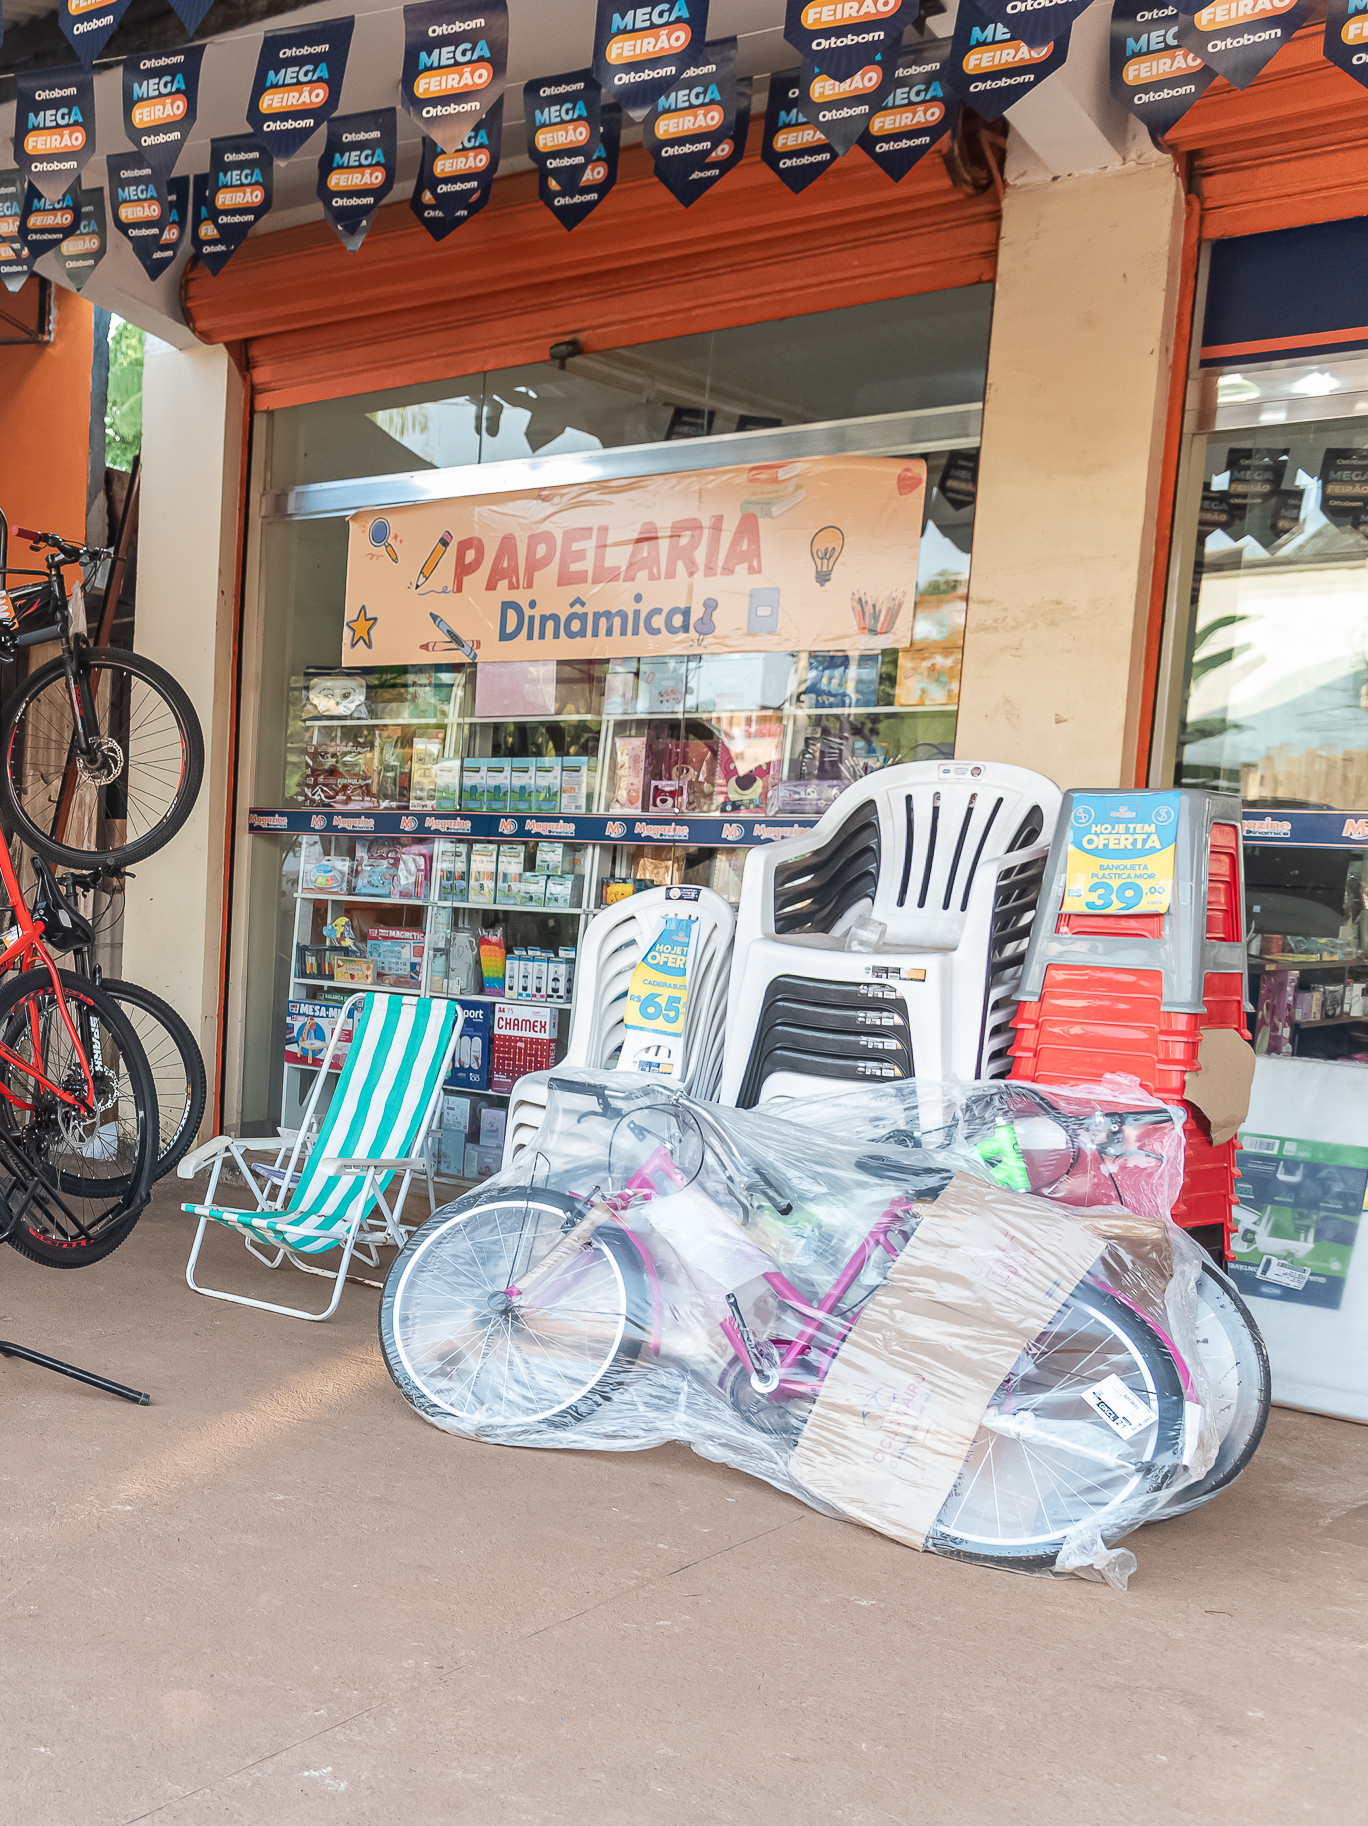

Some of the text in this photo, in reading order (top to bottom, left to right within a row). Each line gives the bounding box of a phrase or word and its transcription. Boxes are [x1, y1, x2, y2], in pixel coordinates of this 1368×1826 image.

[611, 0, 690, 33] MEGA
[1136, 6, 1178, 22] Ortob
[73, 14, 114, 35] Ortobom
[428, 17, 485, 37] Ortobom
[609, 24, 687, 61] FEIRÃO
[811, 31, 885, 51] Ortobom
[1207, 28, 1282, 53] Ortobom
[279, 43, 329, 58] Ortobom
[418, 40, 491, 70] MEGA
[139, 55, 185, 70] Ortobom
[894, 62, 941, 78] rtobom
[265, 62, 329, 87] MEGA
[418, 62, 489, 94] FEIRÃO
[613, 65, 676, 86] Ortobom
[969, 74, 1035, 93] Ortobom
[35, 87, 77, 101] Ortobom
[133, 73, 186, 101] MEGA
[540, 82, 584, 97] Ortobom
[1133, 84, 1196, 105] Ortobom
[262, 85, 325, 111] FEIRÃO
[657, 83, 721, 112] MEGA
[28, 106, 83, 129] MEGA
[134, 97, 185, 124] FEIRÃO
[422, 101, 480, 119] Ortobom
[534, 100, 588, 127] MEGA
[818, 105, 869, 122] Ortobom
[872, 105, 940, 132] FEIRÃO
[262, 118, 314, 132] Ortobom
[658, 108, 720, 137] FEIRÃO
[27, 127, 83, 150] FEIRÃO
[140, 130, 182, 147] Ortobom
[342, 129, 381, 143] Ortobom
[537, 122, 587, 150] FEIRÃO
[875, 136, 930, 153] Ortobom
[224, 151, 260, 162] Ortobom
[332, 148, 385, 169] MEGA
[661, 141, 711, 158] Ortobom
[30, 159, 77, 173] Ortobom
[436, 150, 487, 174] FEIRÃO
[546, 155, 585, 169] Ortobom
[779, 153, 830, 169] Ortobom
[120, 168, 152, 179] Ortobom
[218, 168, 263, 187] MEGA
[330, 167, 383, 189] FEIRÃO
[117, 184, 157, 201] MEGA
[437, 180, 478, 194] Ortobom
[218, 187, 263, 206] FEIRÃO
[332, 195, 374, 207] Ortobom
[29, 212, 72, 227] FEIRÃO
[120, 203, 160, 220] FEIRÃO
[218, 214, 254, 224] Ortobom
[28, 233, 63, 241] Ortobom
[128, 227, 160, 237] Ortobom
[63, 234, 99, 252] FEIRÃO
[65, 258, 95, 269] Ortobom
[452, 512, 764, 594] PAPELARIA
[499, 592, 692, 643] Dinâmica
[332, 815, 375, 830] Magazine
[425, 816, 472, 831] Magazine
[524, 819, 576, 835] Magazine
[634, 821, 690, 839] Magazine
[1091, 823, 1156, 834] HOJE TEM
[1081, 833, 1162, 850] OFERTA
[1099, 863, 1149, 871] BANQUETA
[1085, 881, 1144, 911] 39
[655, 943, 682, 955] HOJE
[647, 951, 686, 969] OFER
[639, 992, 682, 1024] 65
[497, 1016, 547, 1034] CHAMEX
